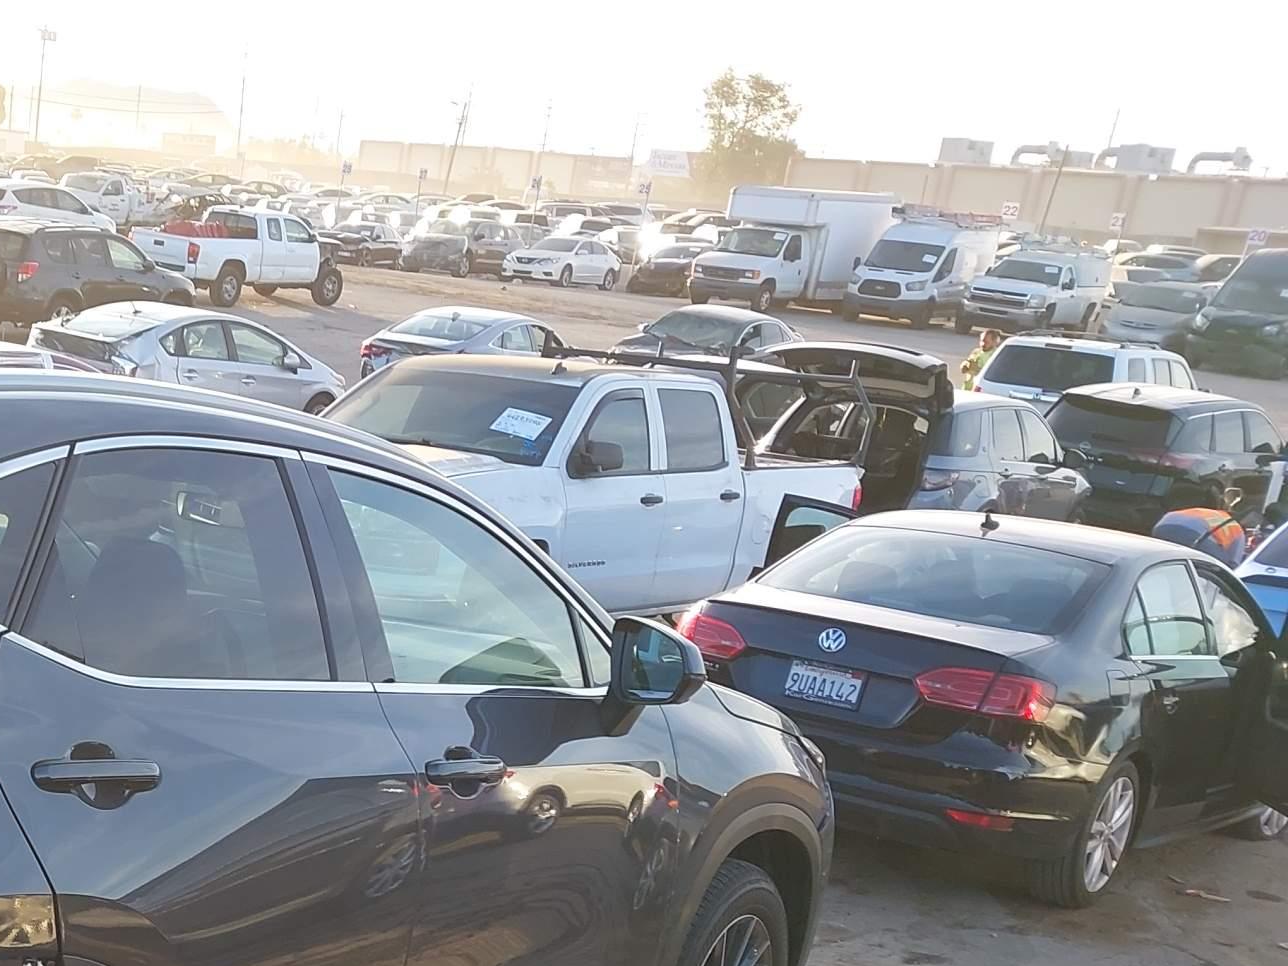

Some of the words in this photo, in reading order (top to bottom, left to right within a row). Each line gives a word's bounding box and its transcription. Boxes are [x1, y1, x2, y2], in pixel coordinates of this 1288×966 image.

[1003, 205, 1018, 217] 22
[1111, 215, 1126, 228] 21
[1249, 229, 1266, 242] 20
[787, 672, 859, 703] 9UAA142
